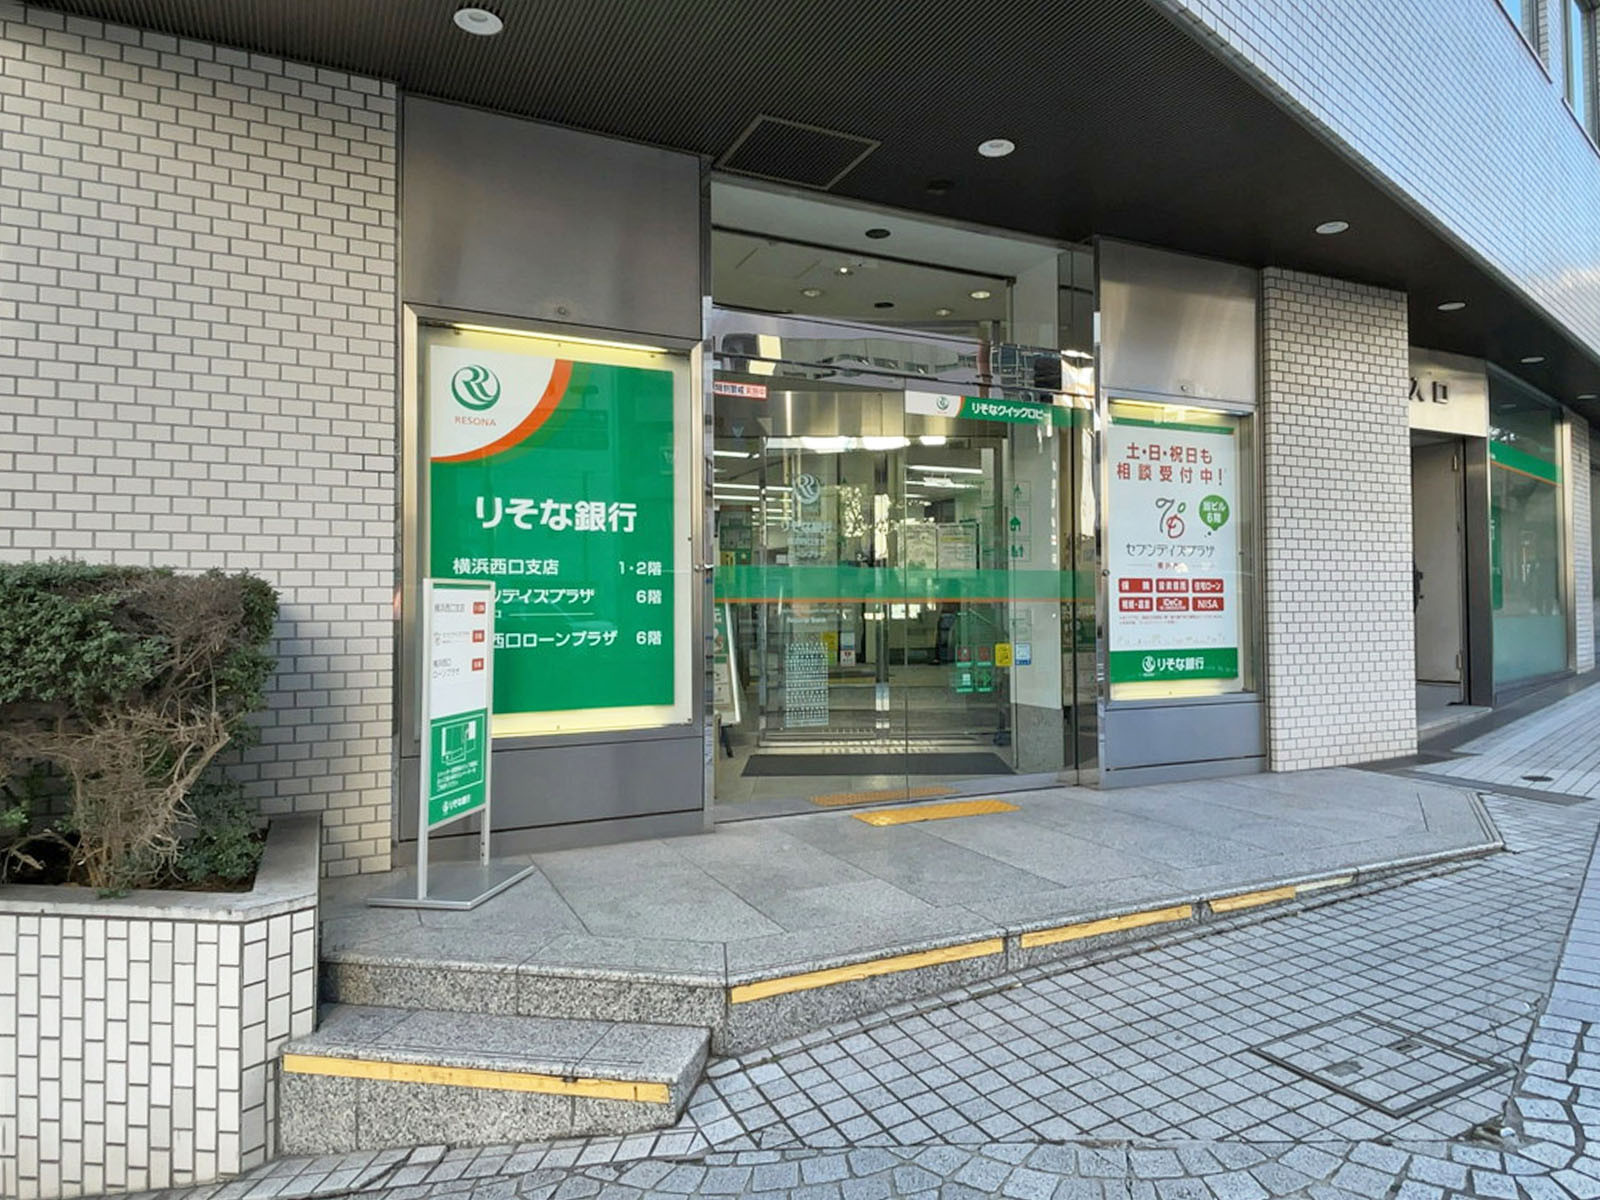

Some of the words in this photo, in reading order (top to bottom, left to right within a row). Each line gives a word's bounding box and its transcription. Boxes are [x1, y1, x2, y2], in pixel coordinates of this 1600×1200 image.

[1408, 377, 1449, 404] 入口
[454, 415, 497, 427] RESONA
[475, 496, 638, 533] りそな銀行
[452, 557, 560, 576] 横浜西口支店
[635, 589, 663, 605] 6階
[1196, 599, 1219, 609] NISA
[635, 630, 663, 646] 6階
[1157, 656, 1205, 672] りそな銀行
